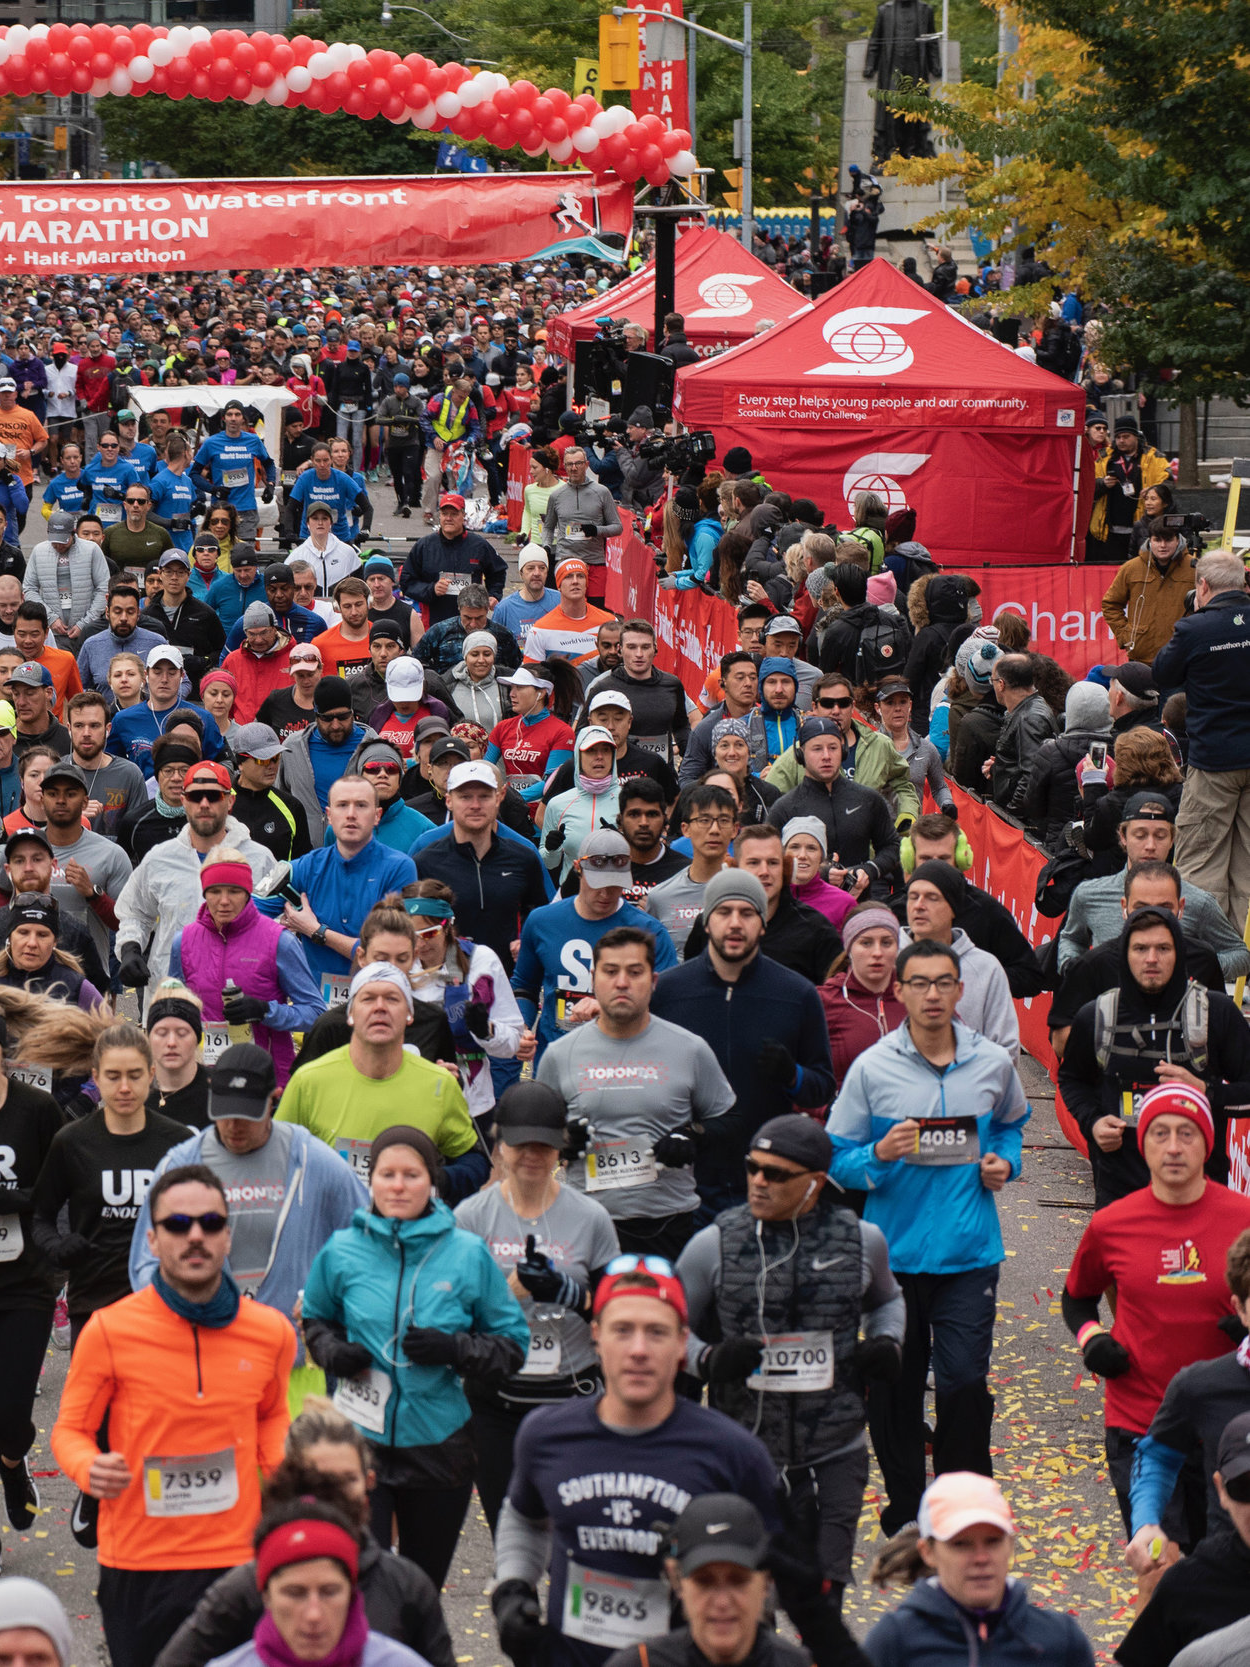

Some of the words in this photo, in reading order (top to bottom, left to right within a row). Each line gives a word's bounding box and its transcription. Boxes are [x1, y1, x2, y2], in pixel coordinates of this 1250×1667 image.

[14, 193, 171, 214] Toronto
[182, 187, 408, 211] Waterfront
[24, 246, 187, 267] Half-Marathon
[739, 394, 770, 409] Every
[772, 396, 798, 409] step
[799, 396, 829, 410] helps
[831, 398, 869, 411] young
[871, 397, 911, 411] people
[914, 396, 937, 408] and
[939, 399, 959, 409] our
[962, 397, 1030, 411] community.
[738, 409, 785, 419] Scotiabank
[786, 410, 816, 421] Charity
[817, 411, 867, 422] Challenge
[920, 1129, 967, 1146] 4085
[597, 1150, 641, 1169] 8613
[766, 1349, 827, 1367] 10700
[164, 1468, 223, 1490] 7359
[558, 1472, 692, 1515] SOUTHAMPTON
[583, 1591, 648, 1621] 9865
